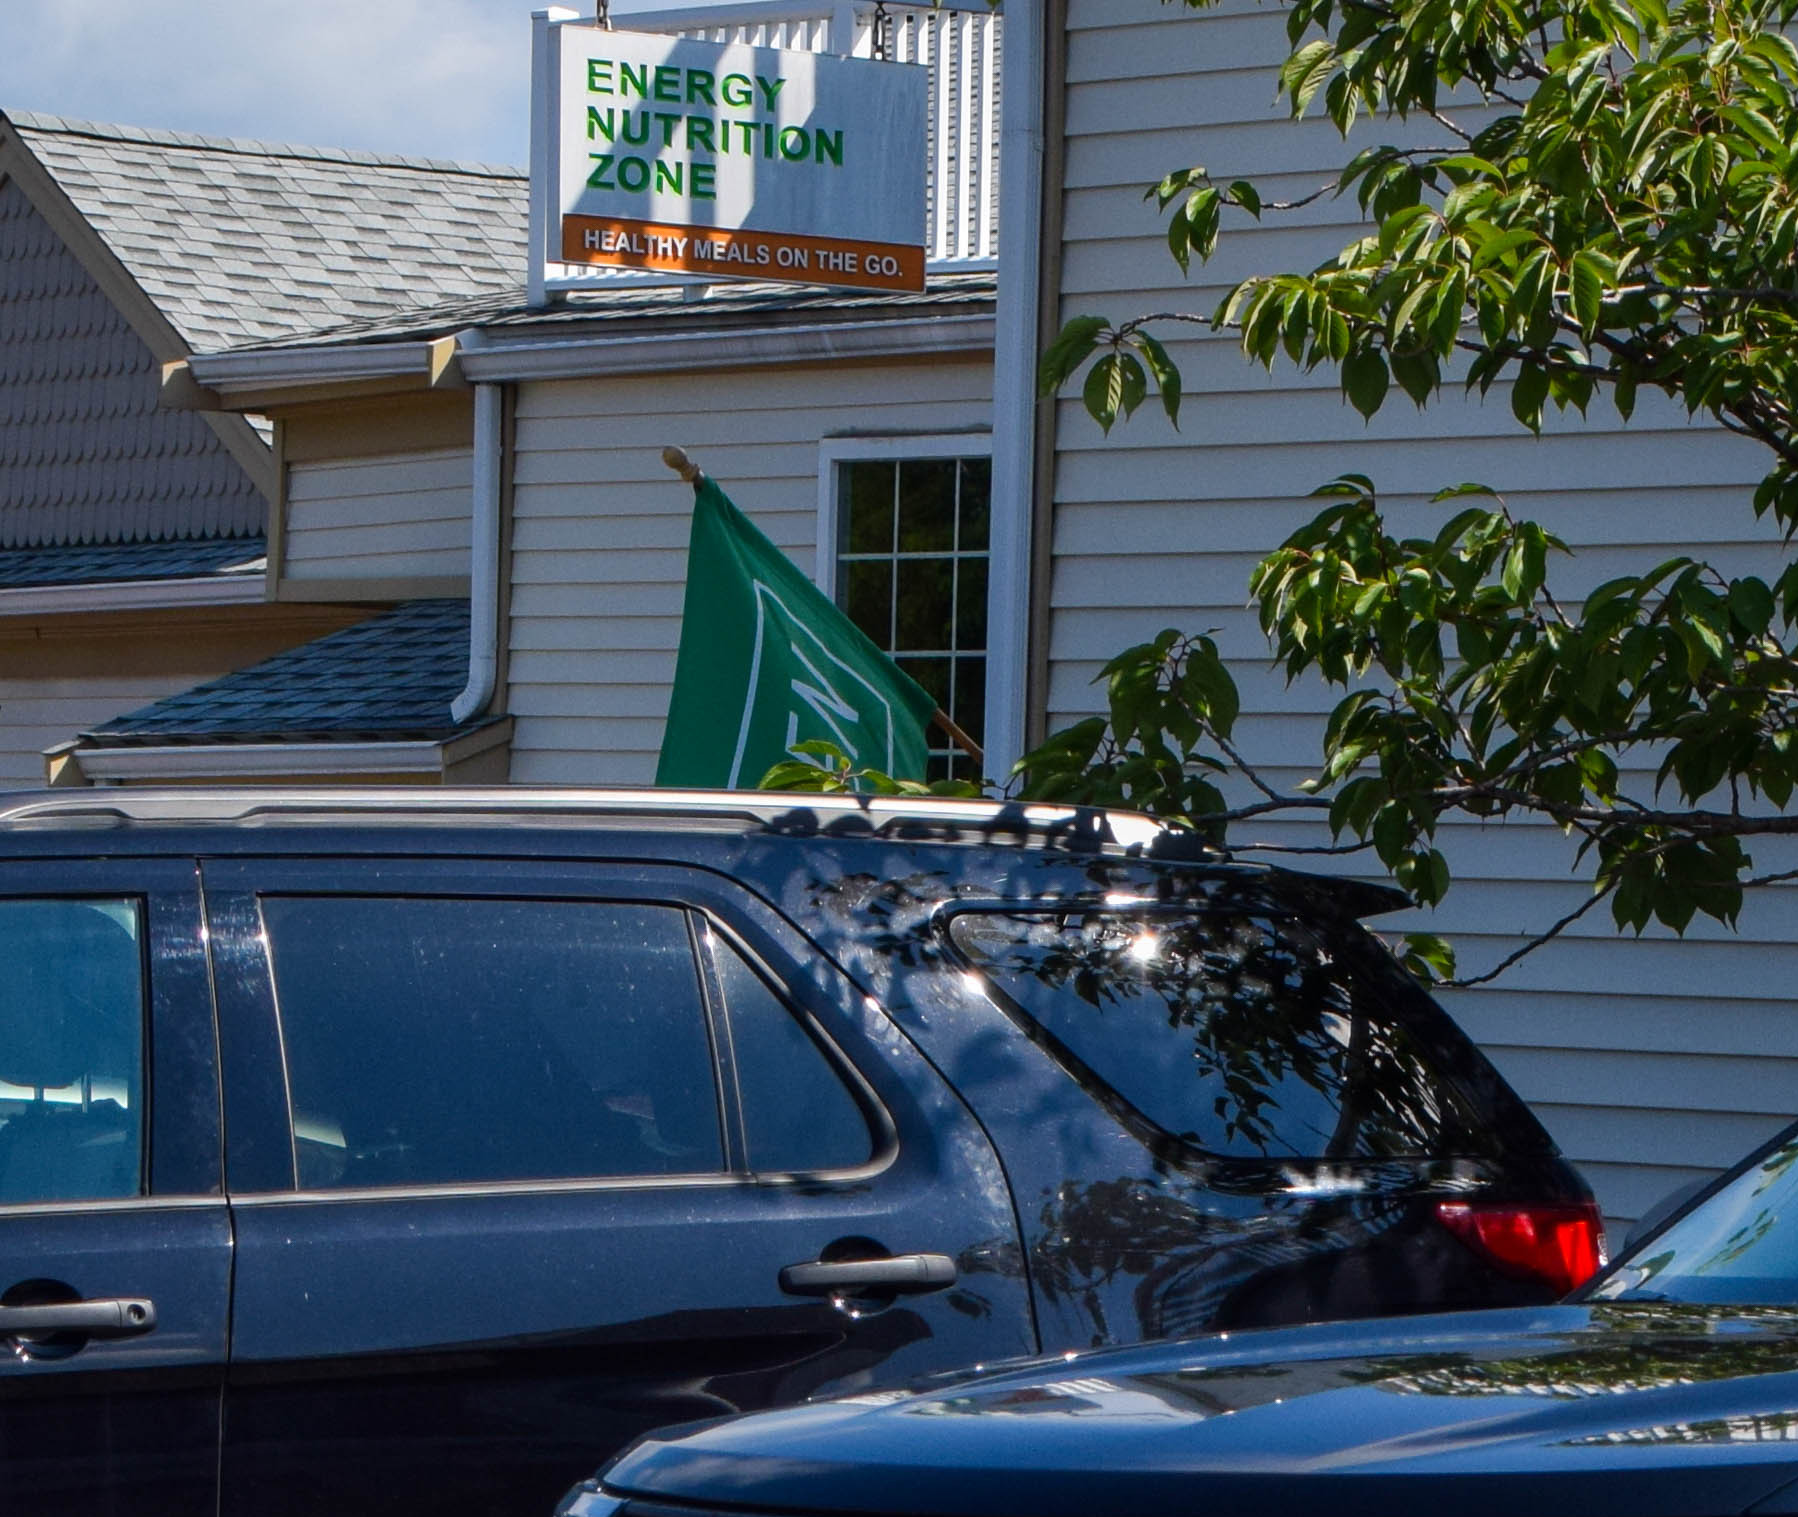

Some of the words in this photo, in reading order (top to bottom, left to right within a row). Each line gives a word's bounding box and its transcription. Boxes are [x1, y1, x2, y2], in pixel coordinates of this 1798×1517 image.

[587, 58, 786, 113] ENERGY
[587, 106, 844, 167] NUTRITION
[586, 153, 718, 200] ZONE
[584, 229, 688, 260] HEALTHY
[693, 238, 771, 267] MEALS
[776, 246, 809, 270] ON
[815, 250, 858, 273] THE
[864, 254, 904, 277] GO.
